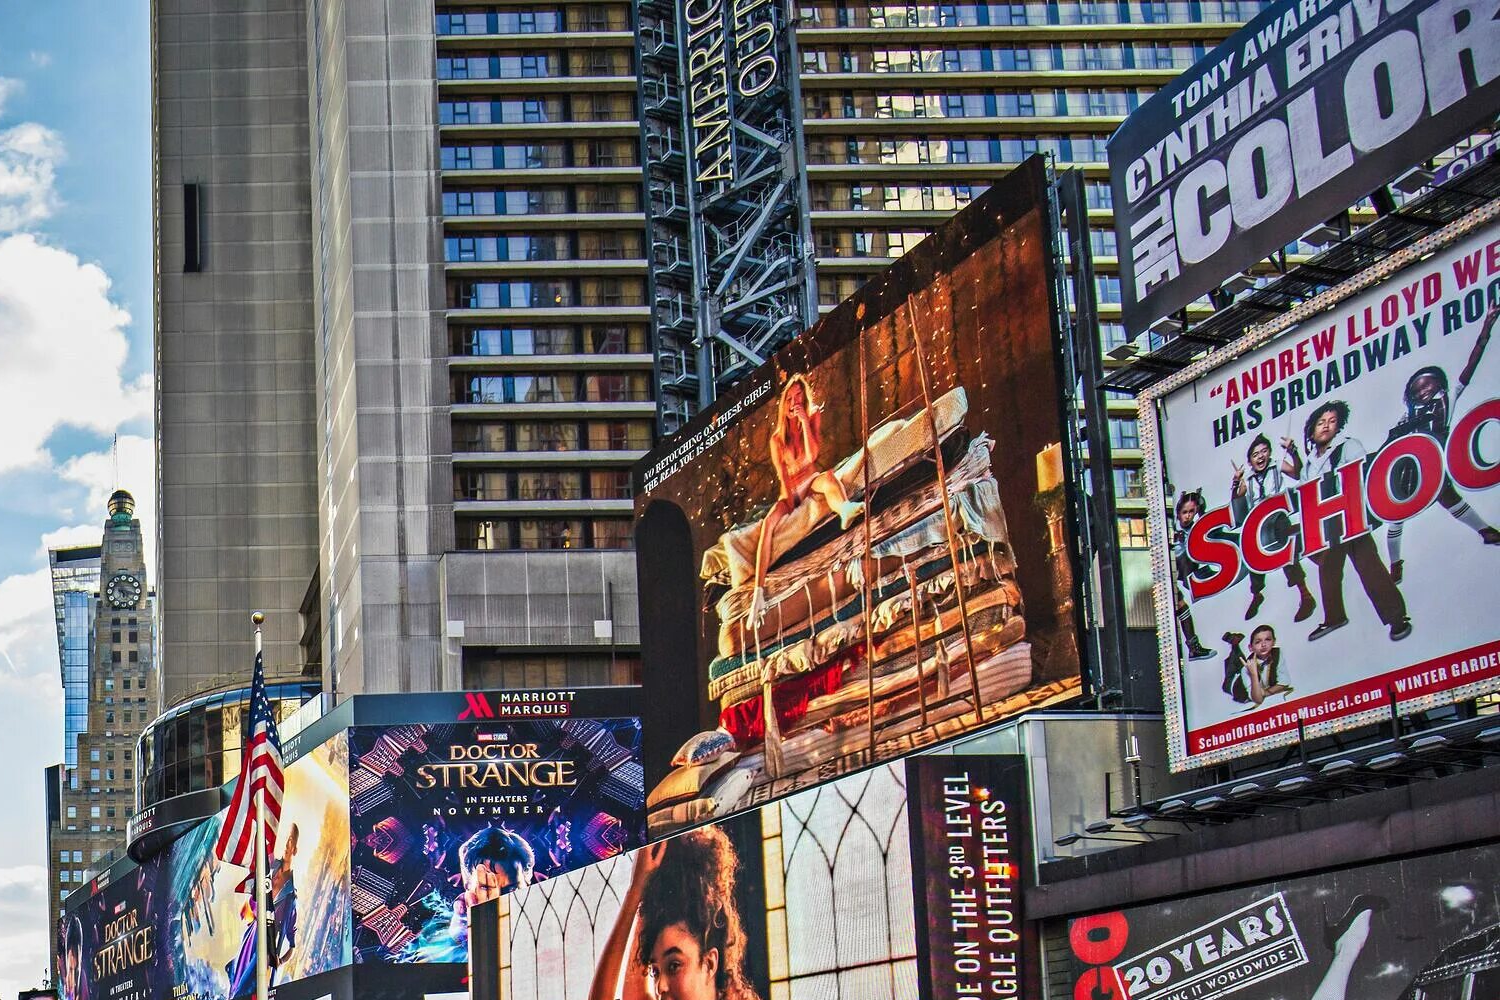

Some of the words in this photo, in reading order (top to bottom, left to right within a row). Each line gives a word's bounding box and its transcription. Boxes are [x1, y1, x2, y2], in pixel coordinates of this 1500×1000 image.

[1125, 63, 1278, 203] CYNTHIA
[1286, 0, 1400, 89] ERIV
[1171, 52, 1235, 118] TONY
[1173, 0, 1500, 265] COLOR
[1130, 189, 1181, 303] THE
[1347, 271, 1442, 343] LLOYD
[1212, 399, 1264, 448] HAS
[1271, 312, 1431, 419] BROADWAY
[655, 432, 703, 473] RETOUCHING
[703, 422, 716, 437] ON
[716, 401, 742, 428] THESE
[743, 380, 771, 407] GIRLS!
[643, 481, 659, 494] THE
[659, 467, 679, 482] REAL
[679, 451, 696, 467] YOU
[696, 442, 705, 457] IS
[501, 691, 576, 702] MARRIOTT
[501, 704, 567, 715] MARQUIS
[1198, 686, 1382, 751] SchoolOfRockTheMusical.com
[1395, 666, 1448, 694] WINTER
[416, 760, 577, 789] STRANGE
[450, 743, 540, 760] DOCTOR
[433, 806, 544, 816] NOVEMBER
[481, 795, 528, 803] THEATERS
[944, 772, 974, 842] LEVEL
[948, 845, 976, 879] 3RD
[979, 798, 1014, 945] OUTFITTERS
[105, 908, 139, 942] DOCTOR
[951, 890, 978, 940] THE
[93, 926, 153, 982] STRANGE
[954, 943, 980, 974] ON
[1123, 958, 1173, 996] 20
[1169, 904, 1285, 973] YEARS
[1204, 951, 1288, 993] WORLDWIDE
[115, 979, 133, 994] THEATERS
[173, 982, 189, 998] TILDA
